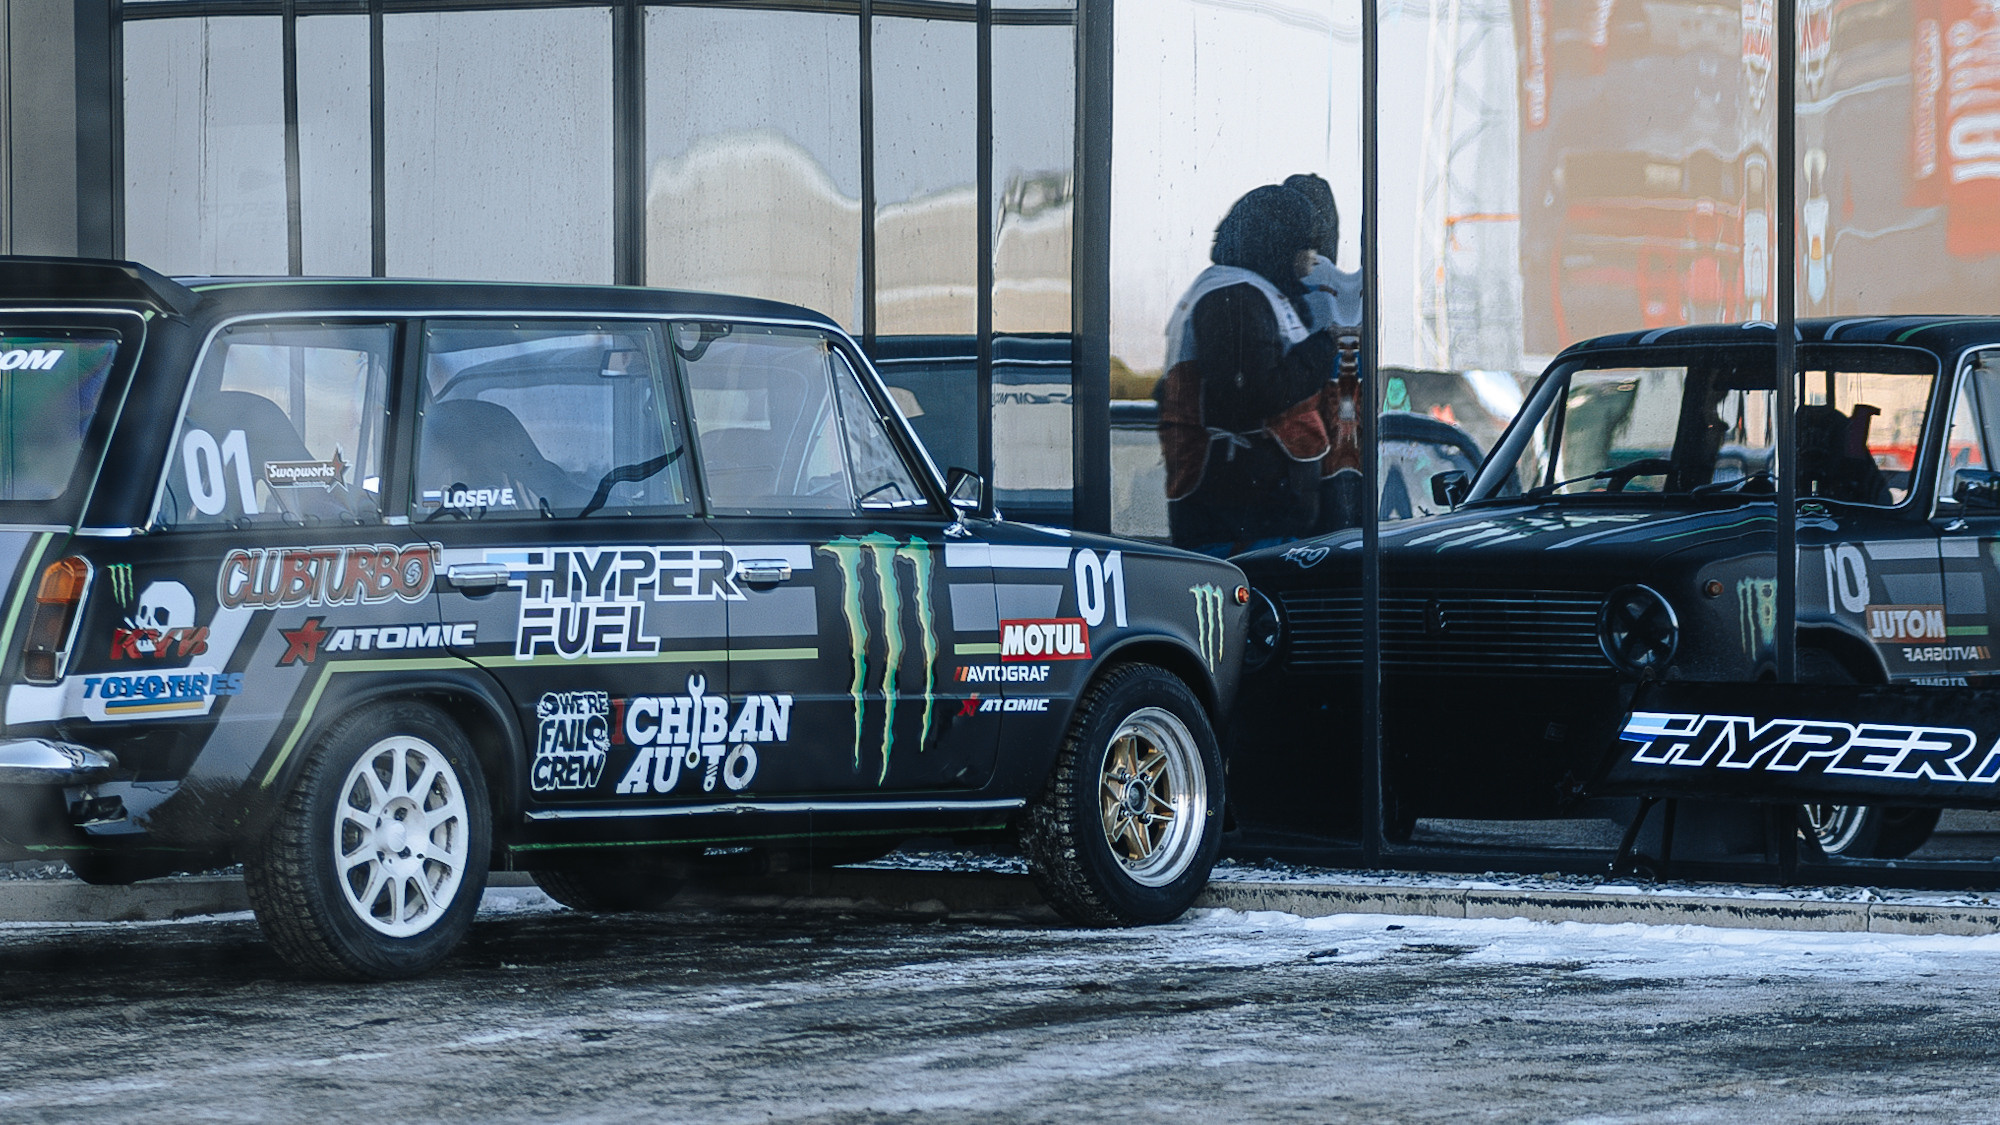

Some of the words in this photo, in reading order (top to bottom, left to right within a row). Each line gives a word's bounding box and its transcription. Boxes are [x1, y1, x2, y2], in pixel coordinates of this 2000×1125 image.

[0, 350, 64, 370] OM
[182, 429, 259, 515] 01
[269, 464, 335, 481] Swapworks
[443, 489, 500, 508] LOSEV
[501, 488, 516, 505] E.
[503, 546, 748, 601] HYPER
[1075, 548, 1128, 627] 01
[325, 623, 477, 651] ATOMIC
[515, 601, 661, 660] FUEL
[1002, 623, 1086, 656] MOTUL
[83, 677, 164, 699] TOYO
[167, 672, 244, 697] TIRES
[979, 698, 1050, 712] ATOMIC
[1619, 711, 1977, 782] HYPER
[531, 752, 606, 791] CREW
[615, 744, 757, 794] AUTO
